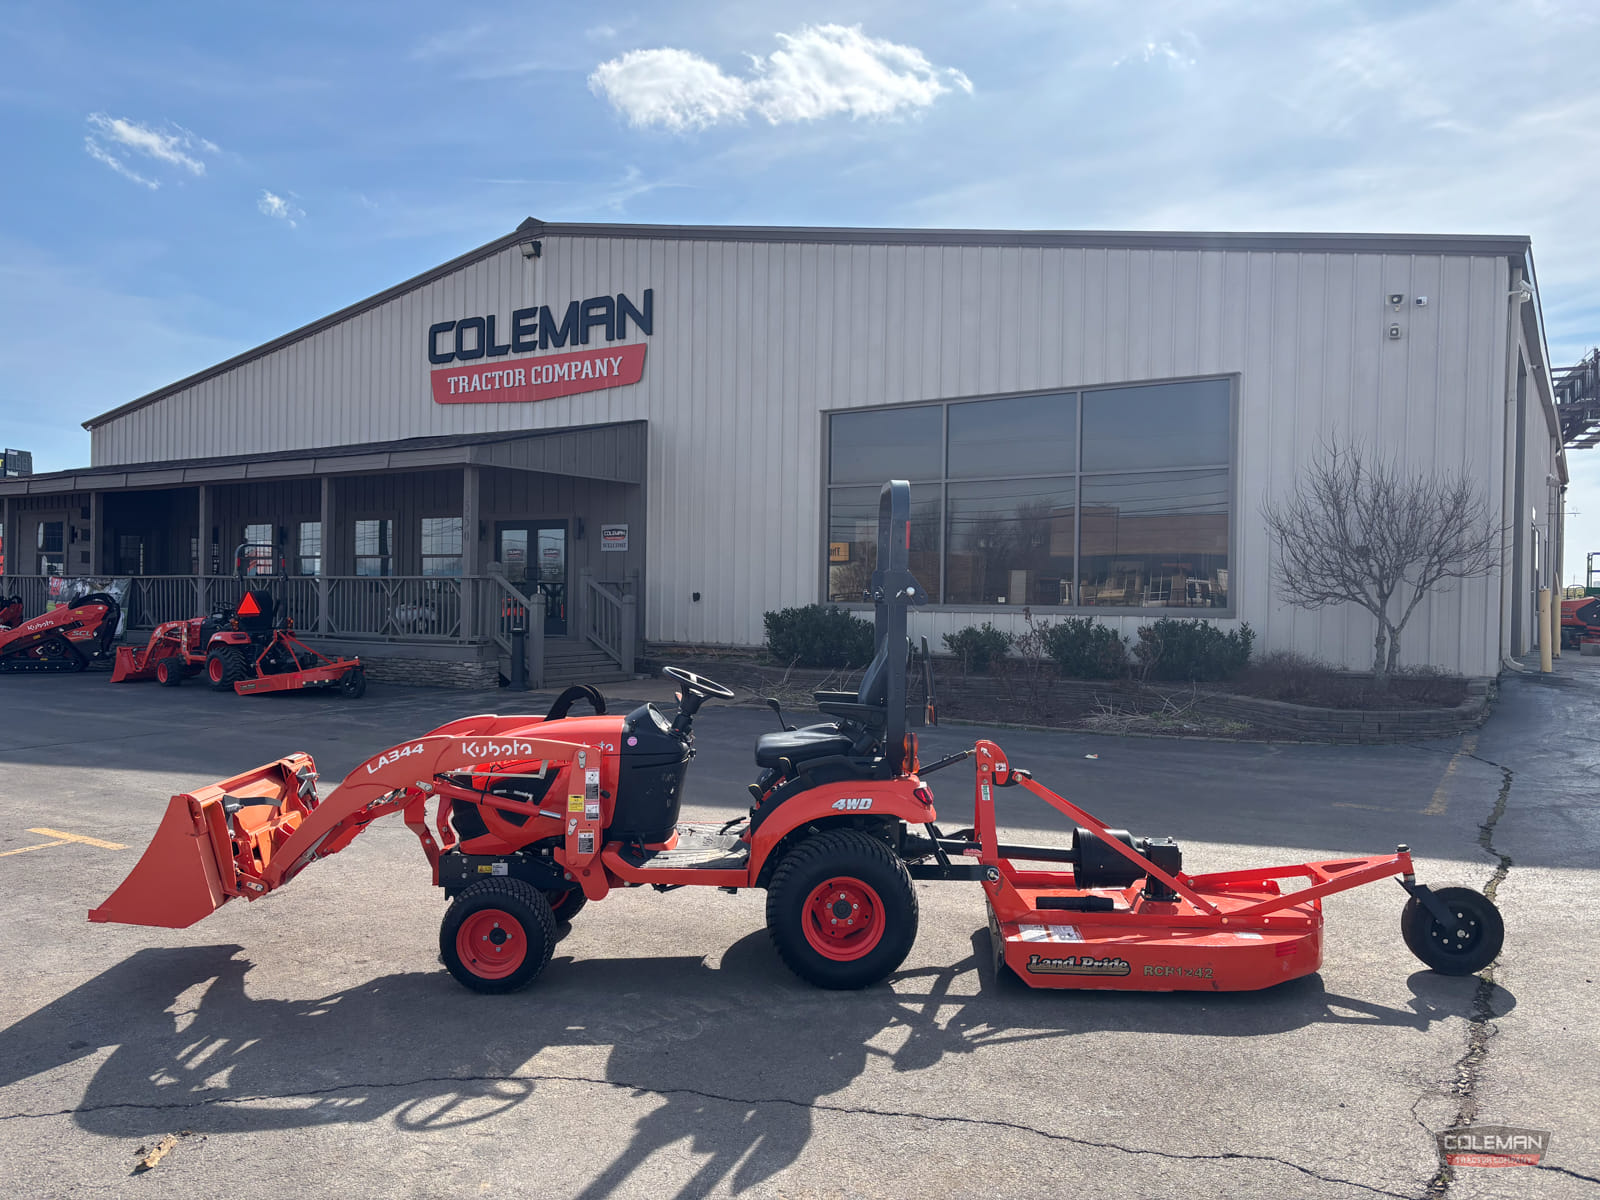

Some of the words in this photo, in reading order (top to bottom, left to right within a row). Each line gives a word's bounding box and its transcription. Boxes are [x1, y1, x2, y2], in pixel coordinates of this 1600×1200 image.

[428, 288, 653, 365] COLEMAN
[447, 367, 526, 395] TRACTOR
[531, 356, 623, 385] COMPANY
[27, 620, 54, 631] Kubota
[462, 740, 532, 758] Kubota
[366, 743, 425, 775] LA344
[831, 797, 873, 811] 4WD
[1029, 955, 1075, 969] Land
[1080, 956, 1129, 969] Pride
